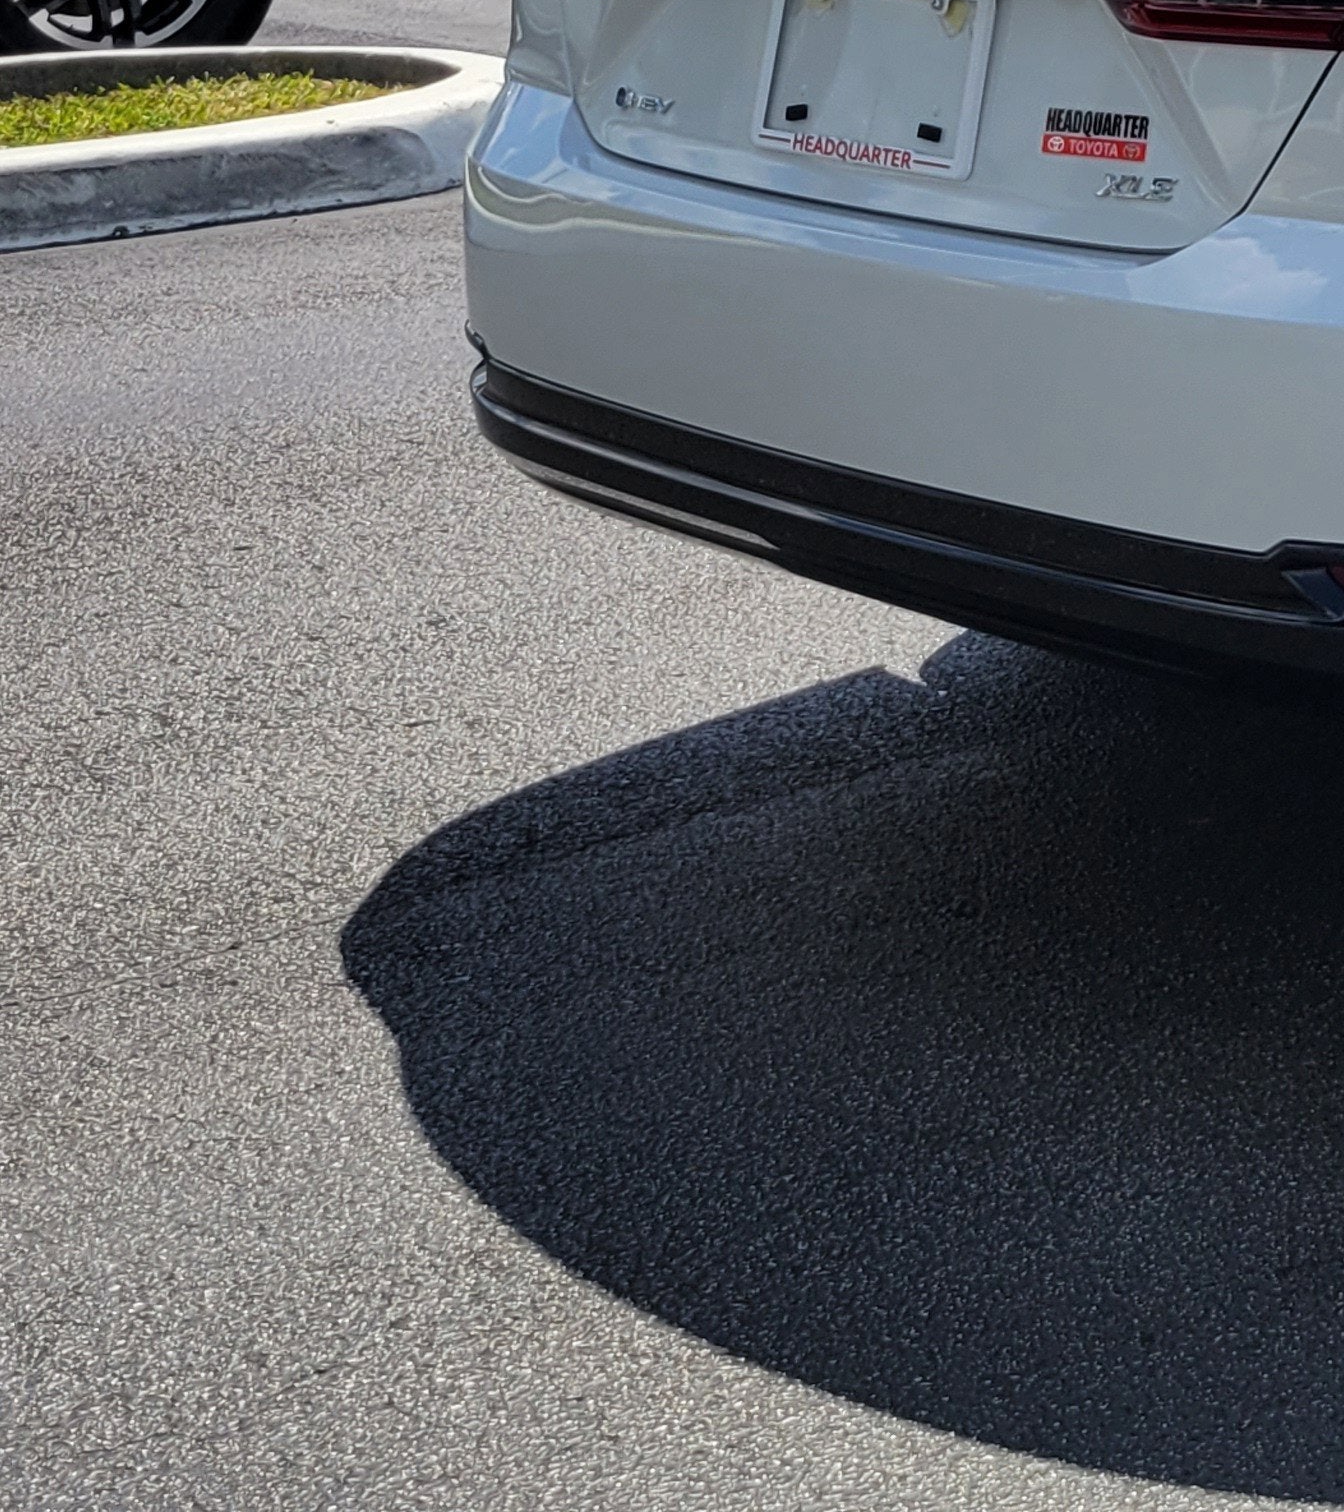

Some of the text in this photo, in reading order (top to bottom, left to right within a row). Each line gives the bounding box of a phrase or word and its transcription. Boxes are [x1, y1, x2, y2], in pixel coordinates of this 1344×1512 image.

[1045, 107, 1150, 140] HEADQUARTER
[792, 132, 912, 170] HEADQUARTER
[1068, 139, 1119, 158] TOYOTA
[1095, 172, 1180, 202] XLE
